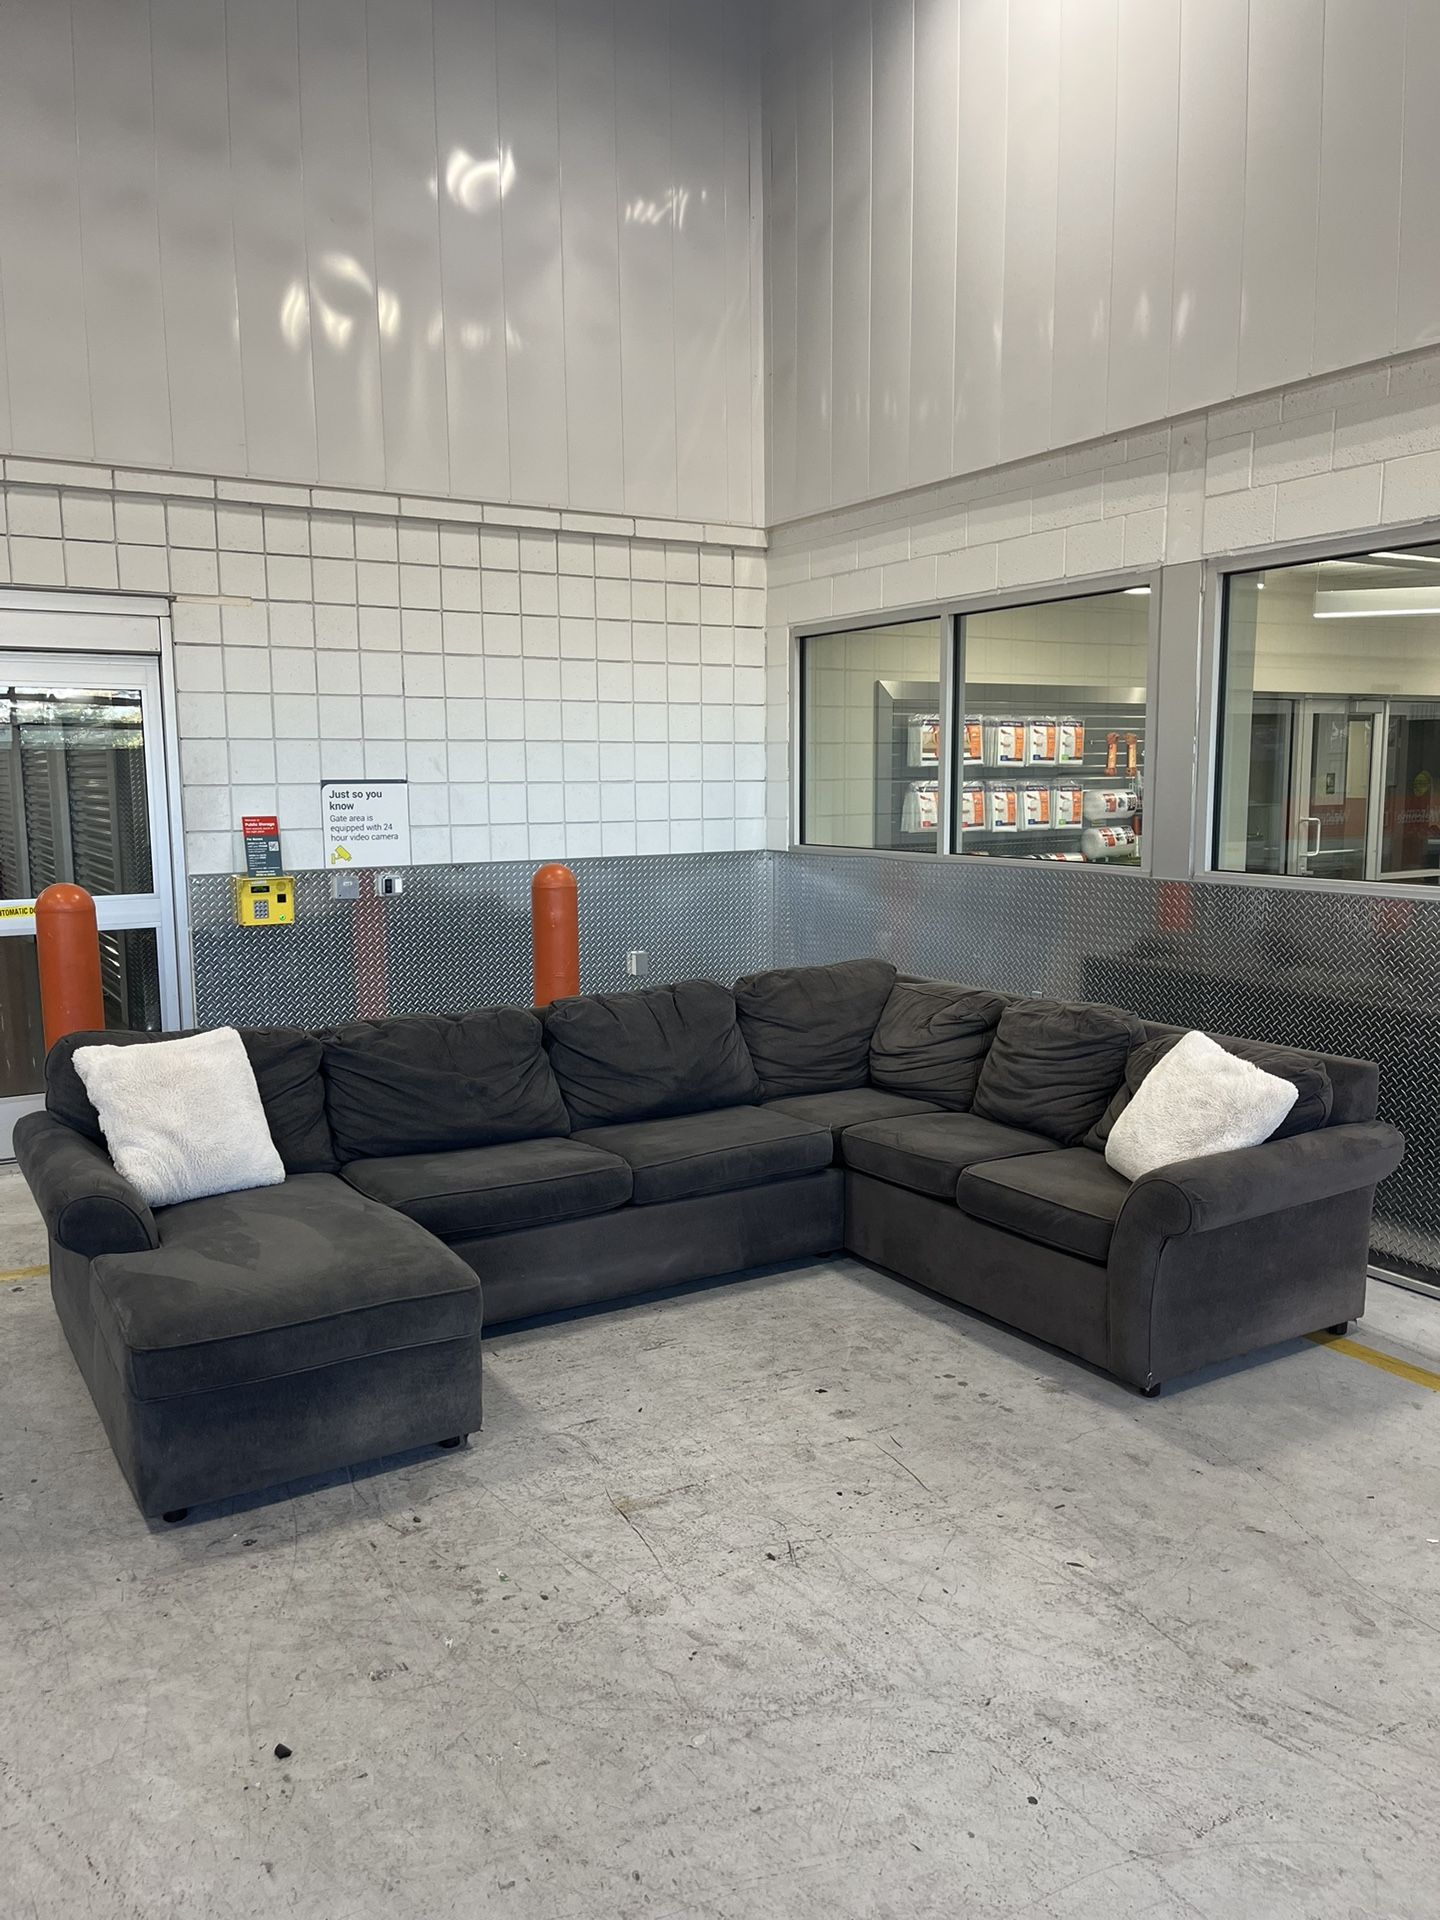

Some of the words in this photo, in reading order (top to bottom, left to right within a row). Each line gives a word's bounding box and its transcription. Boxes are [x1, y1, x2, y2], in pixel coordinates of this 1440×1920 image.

[329, 790, 350, 799] Just
[352, 791, 363, 799] so
[365, 791, 382, 800] you
[329, 801, 354, 810] know
[329, 814, 347, 822] Gate
[330, 824, 364, 833] equipped
[366, 823, 382, 831] with
[383, 823, 393, 831] 24
[330, 834, 348, 842] hour
[350, 833, 369, 841] video
[371, 833, 399, 841] camera
